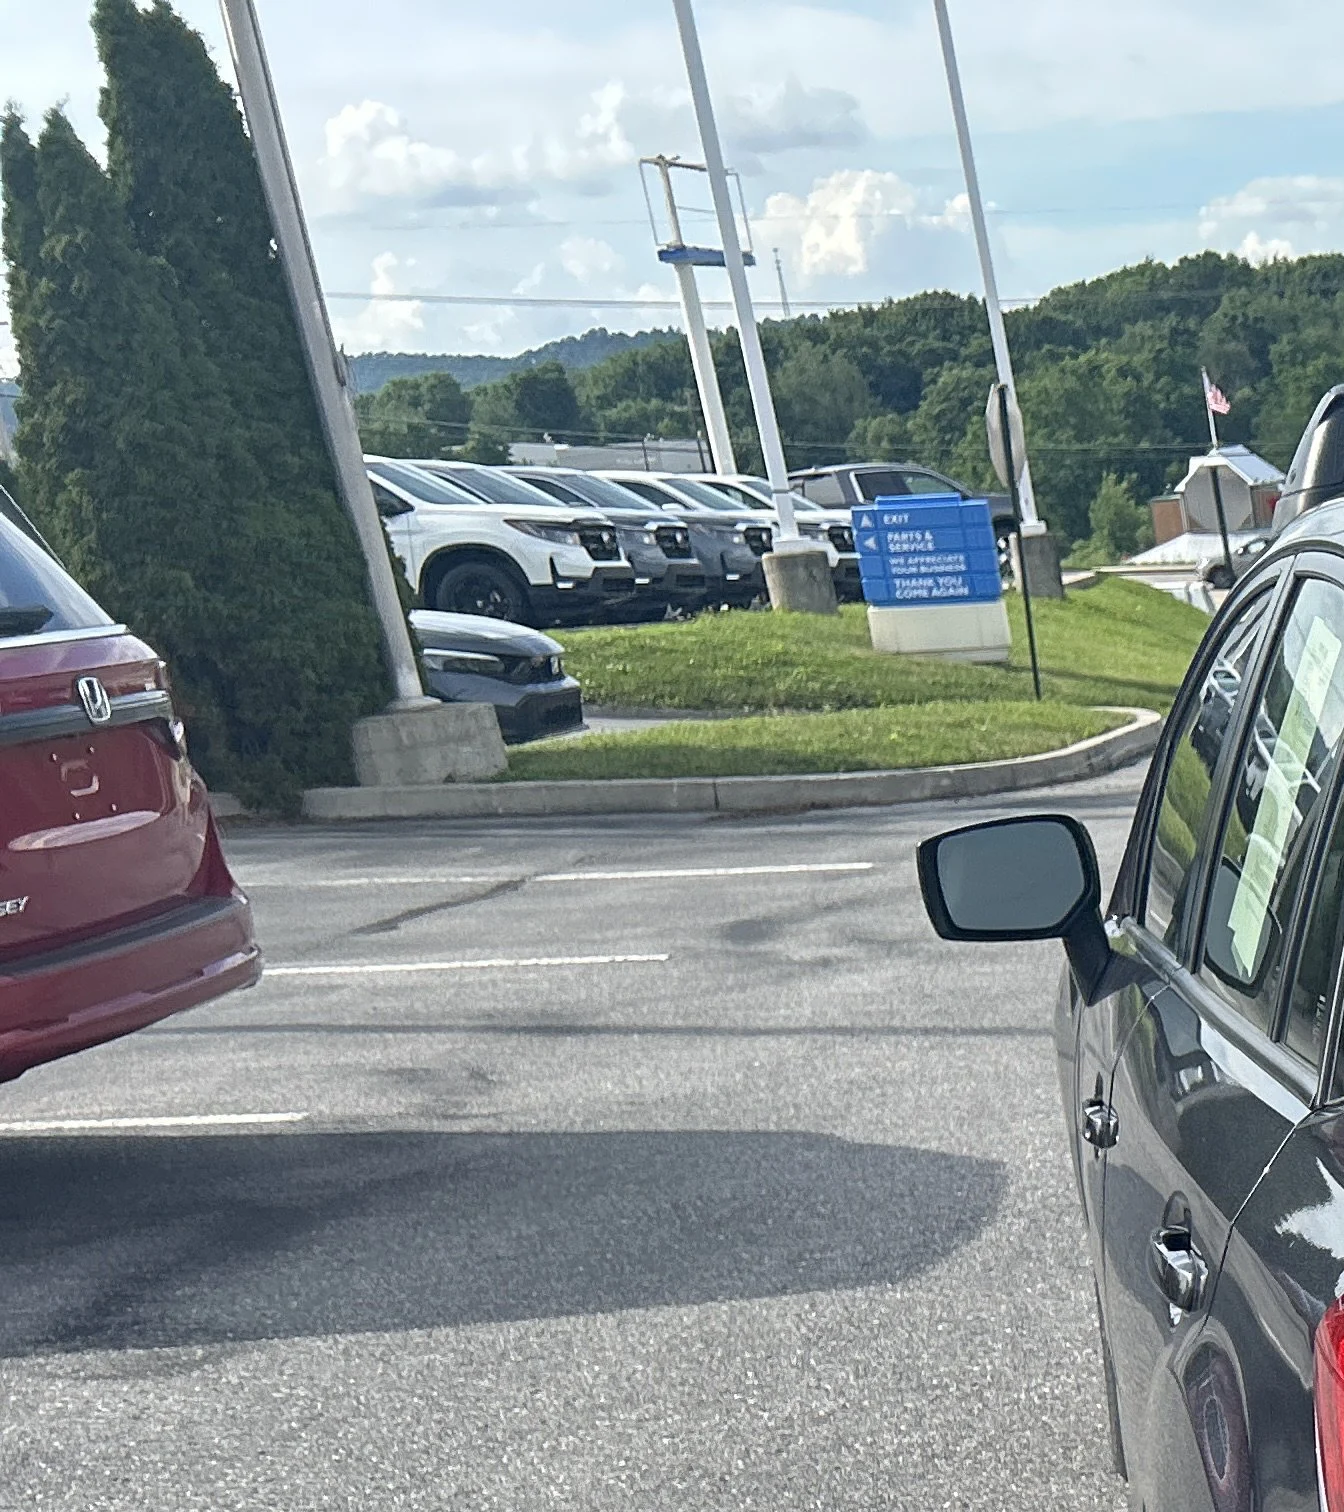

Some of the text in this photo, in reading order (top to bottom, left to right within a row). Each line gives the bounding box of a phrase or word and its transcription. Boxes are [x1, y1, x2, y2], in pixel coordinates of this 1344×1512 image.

[883, 512, 909, 524] EXIT
[887, 531, 923, 542] PARTS
[888, 542, 935, 553] SERVICE
[906, 554, 965, 565] APPRECIATE
[894, 575, 963, 588] THANK YOU
[896, 585, 969, 599] COME AGAIN
